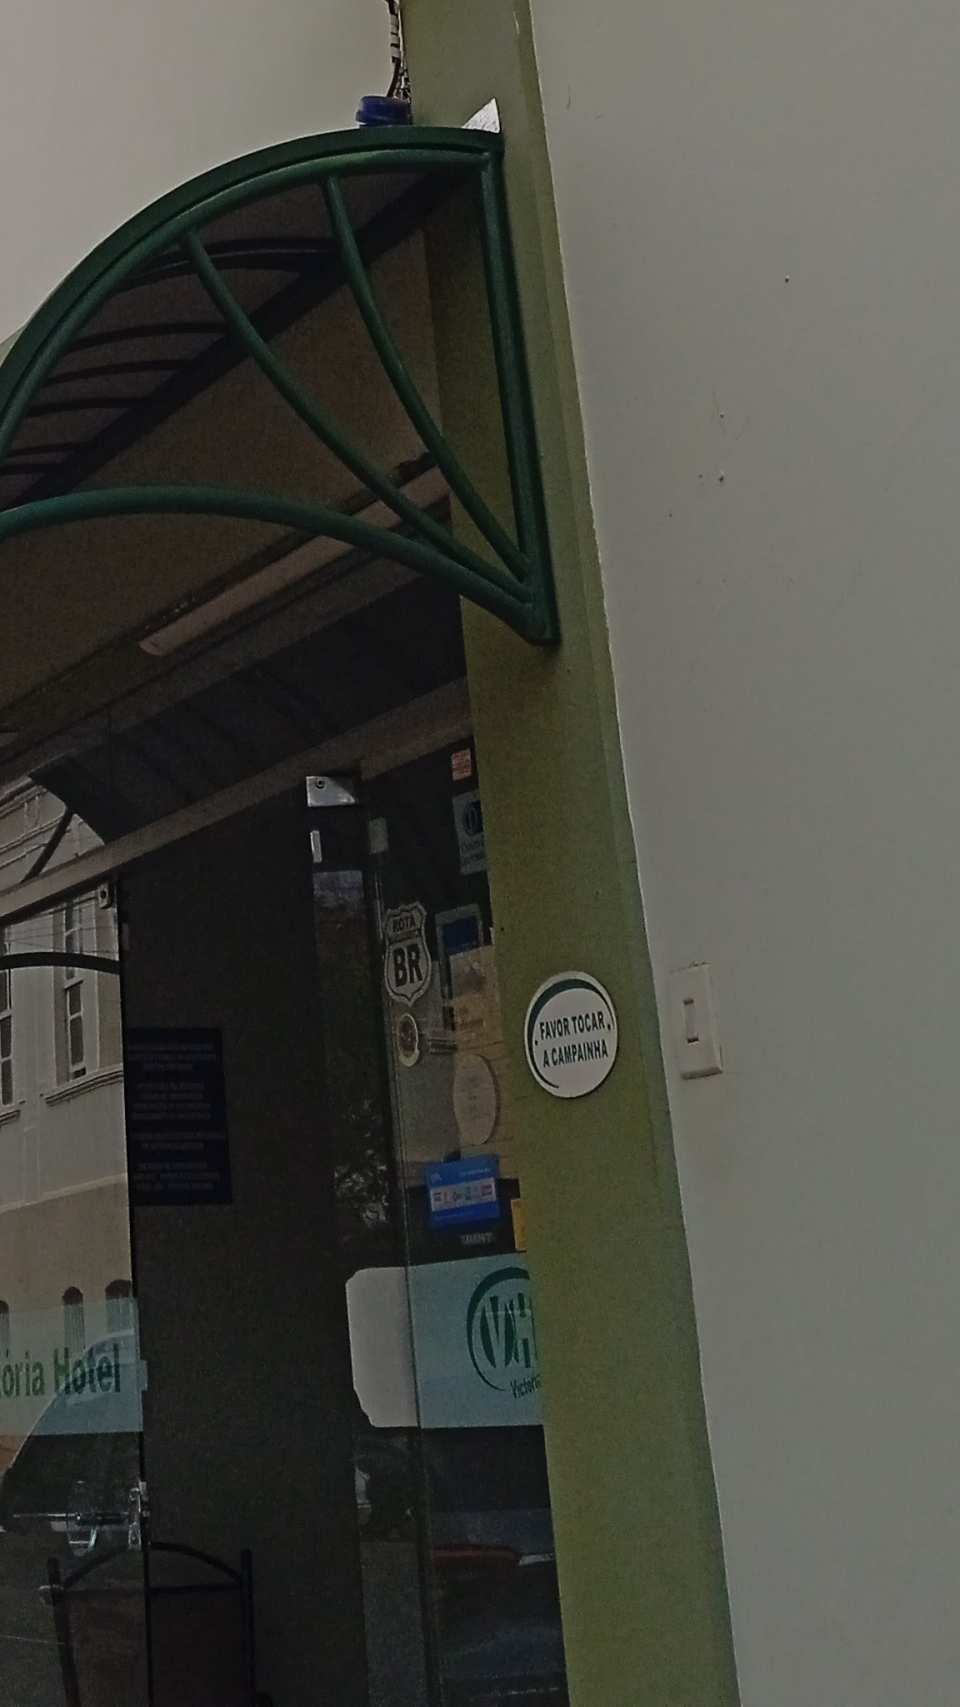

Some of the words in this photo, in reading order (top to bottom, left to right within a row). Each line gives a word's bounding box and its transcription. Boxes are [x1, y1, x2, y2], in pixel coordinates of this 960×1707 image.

[392, 915, 416, 934] ROTA
[393, 943, 423, 988] BR
[539, 1017, 571, 1041] FAVOR
[571, 1011, 606, 1035] TOCAR
[543, 1050, 551, 1068] A
[551, 1038, 609, 1067] CAMPAINHA
[53, 1343, 121, 1397] Hotel
